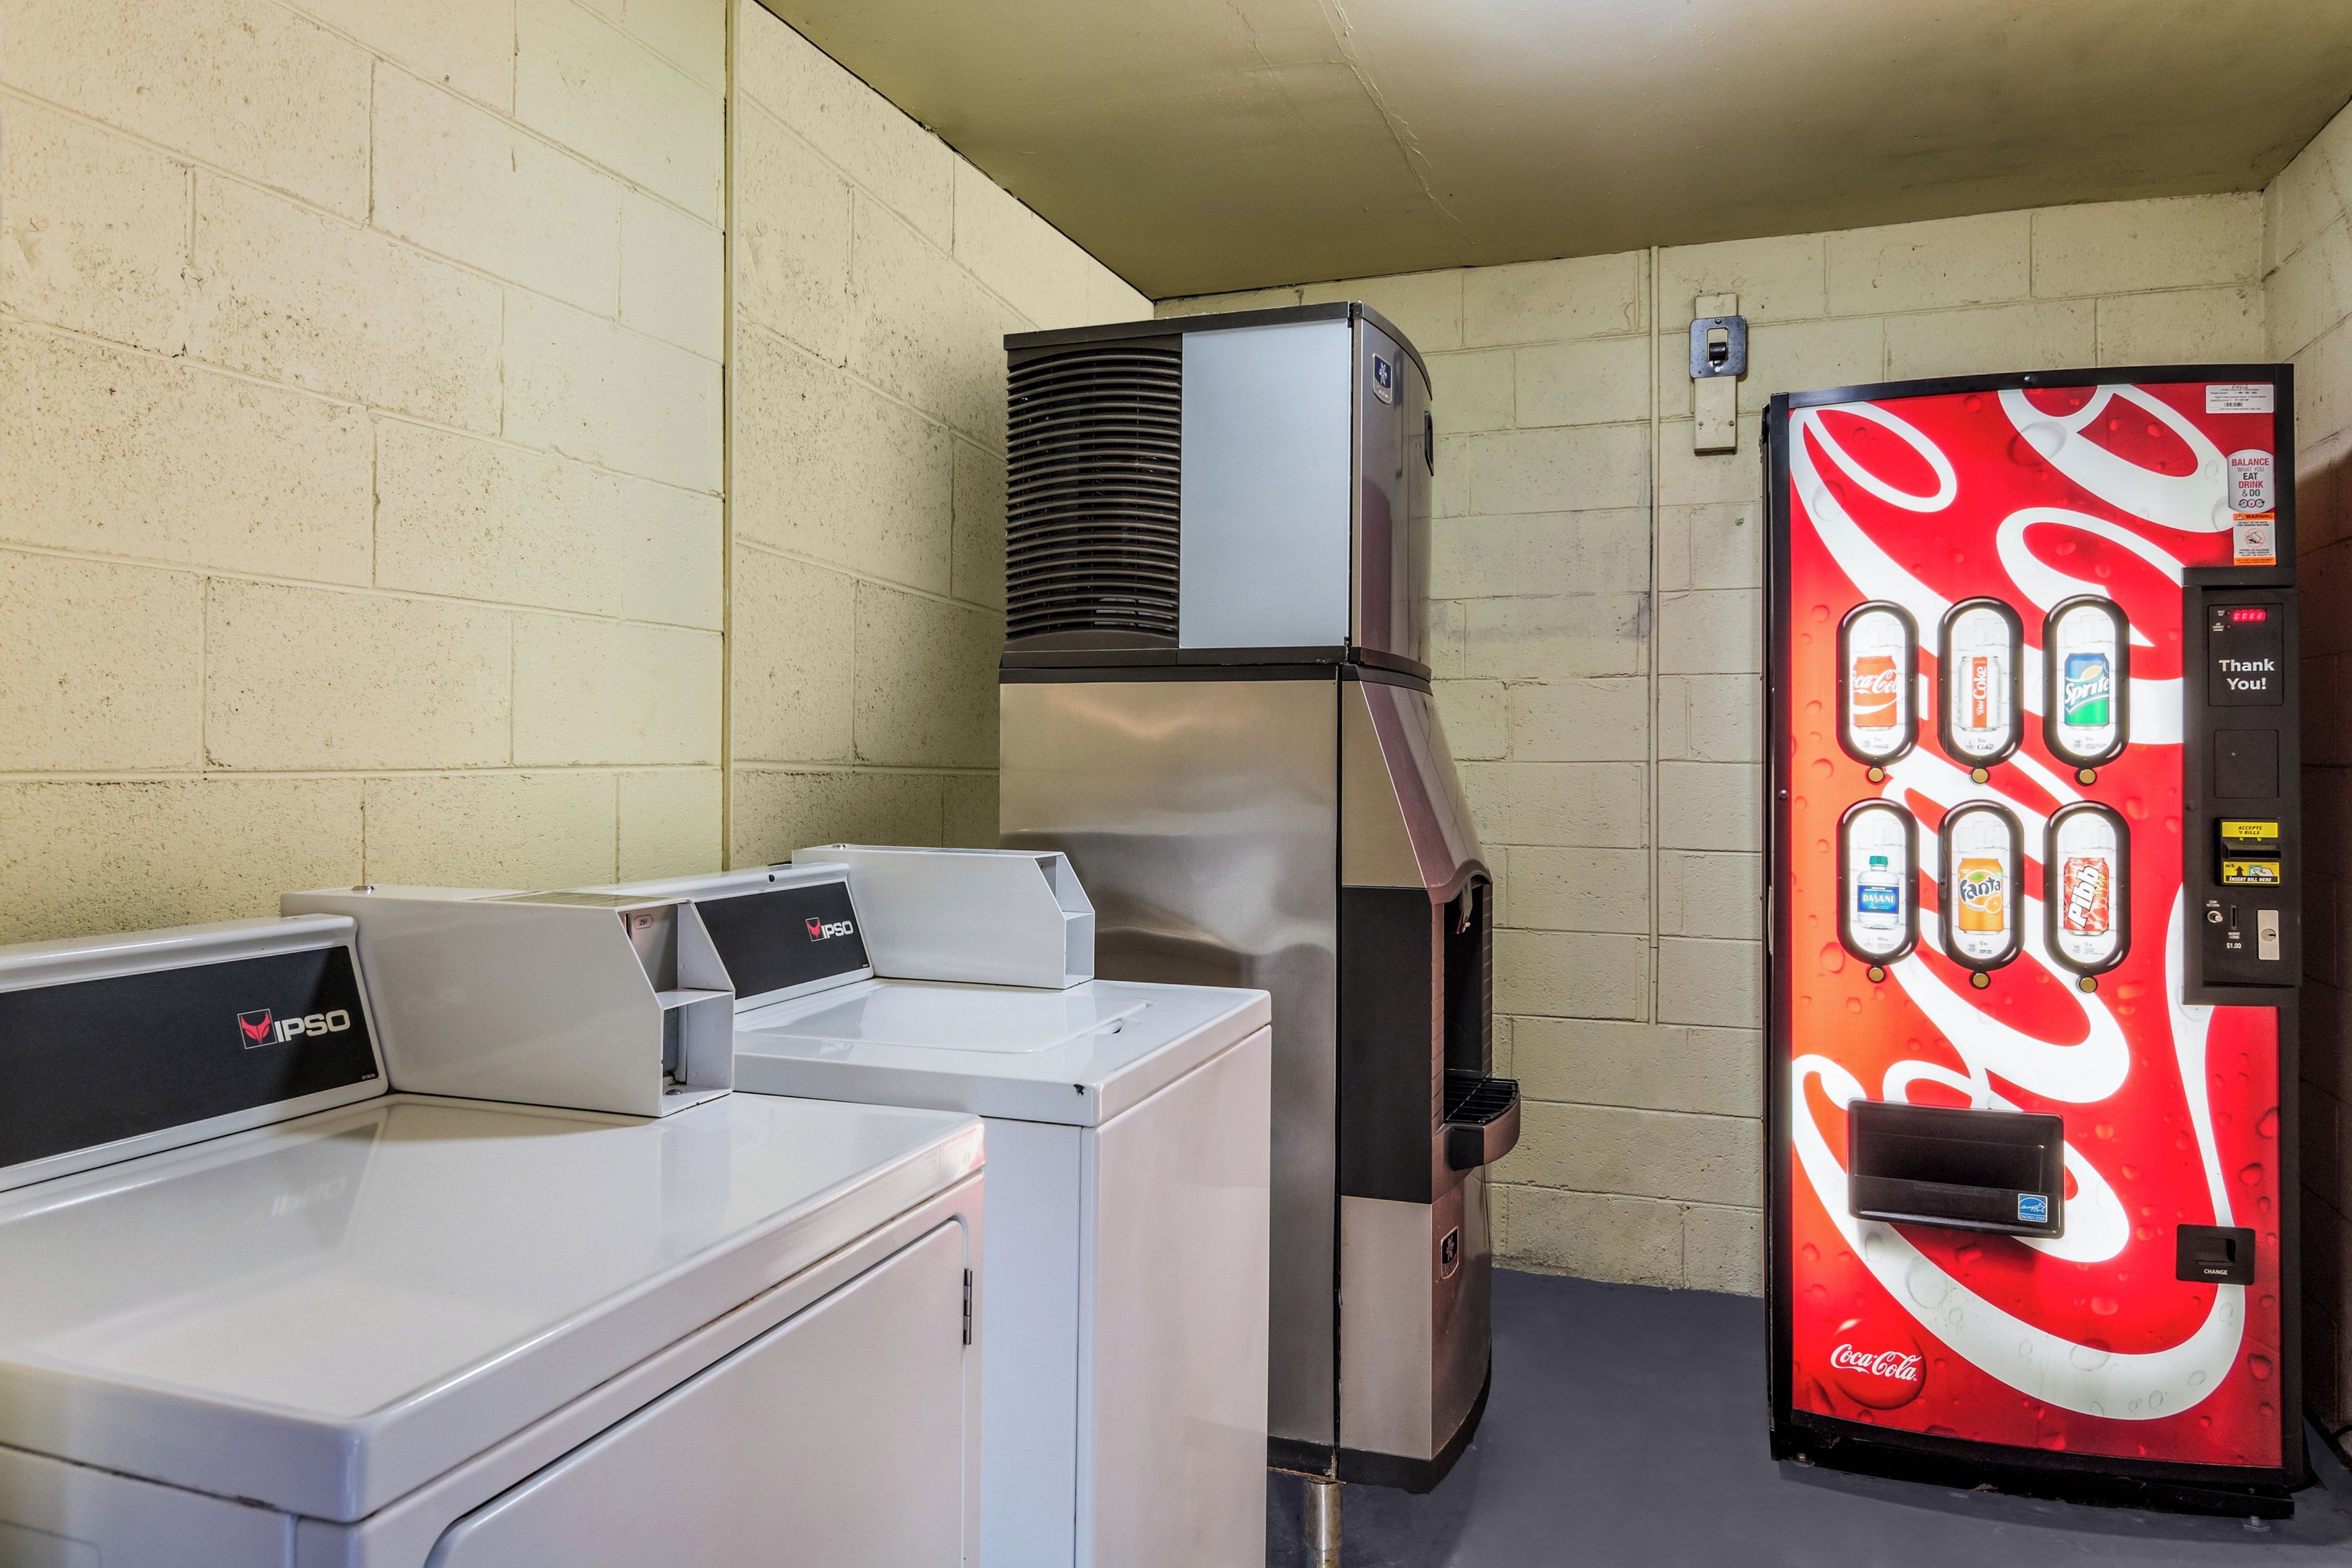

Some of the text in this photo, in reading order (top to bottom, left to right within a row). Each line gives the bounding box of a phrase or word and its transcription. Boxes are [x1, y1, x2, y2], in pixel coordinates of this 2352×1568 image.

[2218, 658, 2275, 671] Thank
[1973, 666, 1987, 699] Coke
[2065, 674, 2109, 706] Sprite
[2226, 677, 2267, 690] You!
[1863, 892, 1894, 903] DASANI
[821, 921, 854, 939] IPSO
[274, 1009, 350, 1042] IPSO
[1831, 1344, 1922, 1381] Coca-Cola
